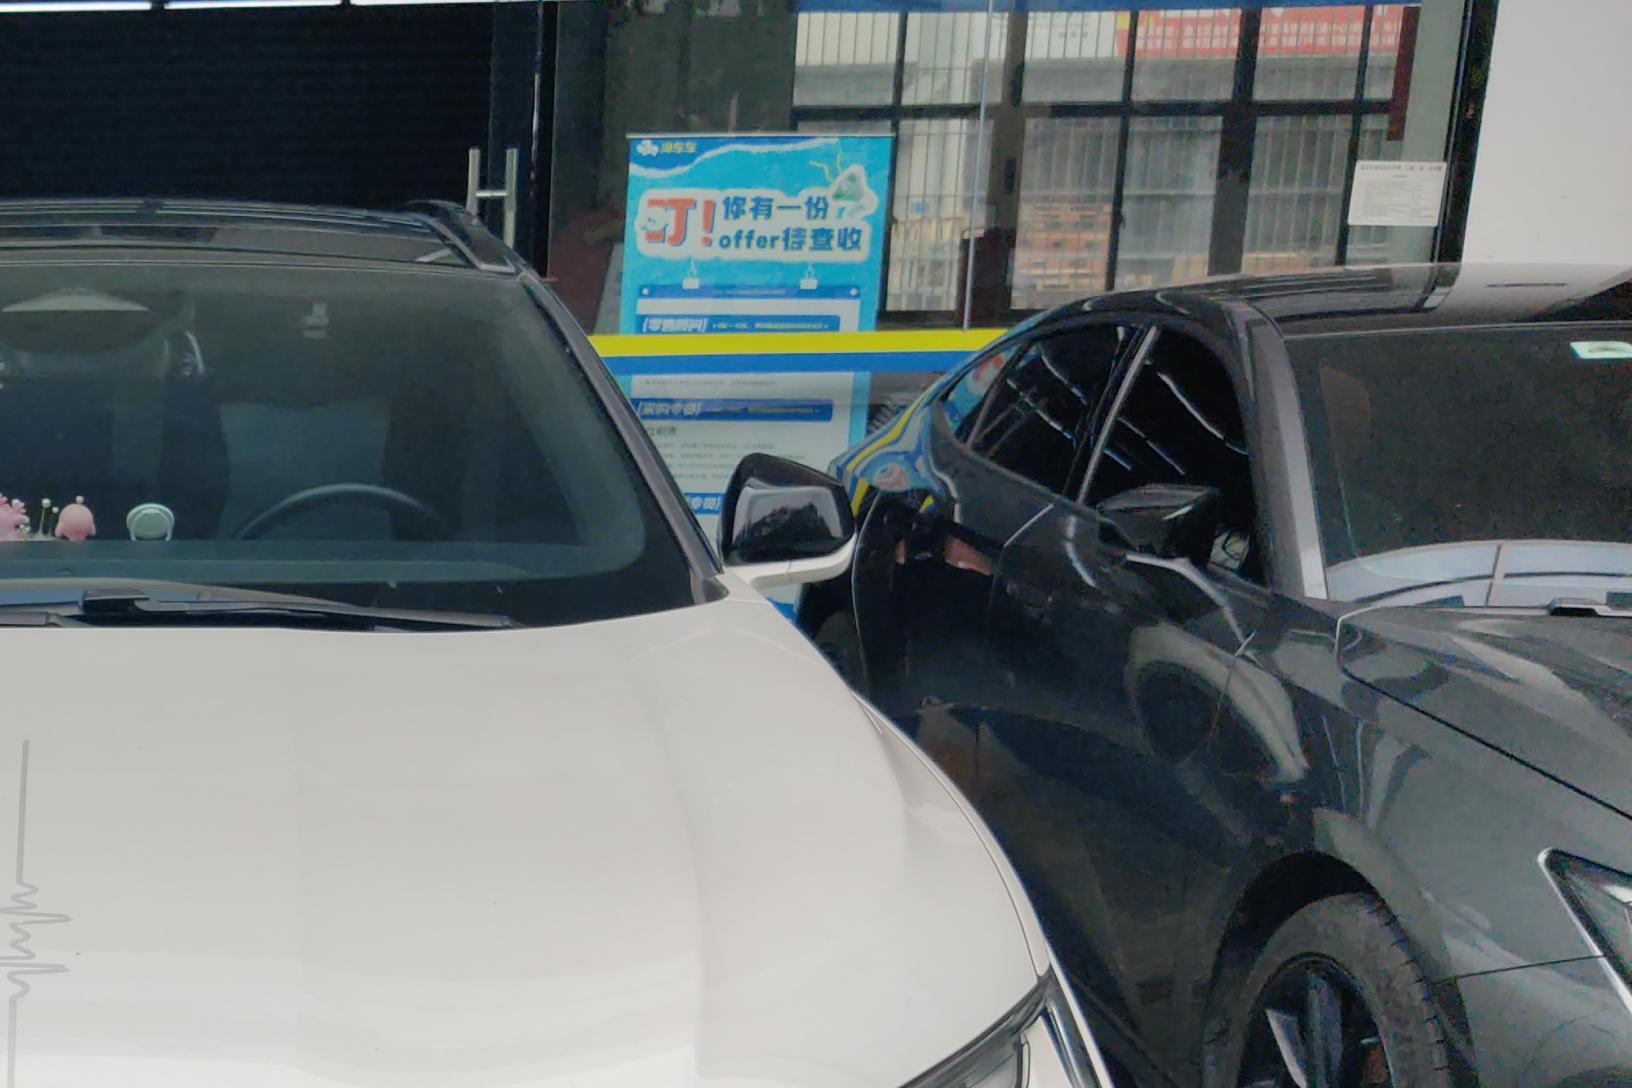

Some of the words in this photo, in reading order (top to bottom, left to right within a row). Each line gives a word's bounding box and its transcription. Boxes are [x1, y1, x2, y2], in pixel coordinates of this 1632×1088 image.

[722, 196, 829, 220] 你有一份
[718, 228, 862, 251] offer待查收
